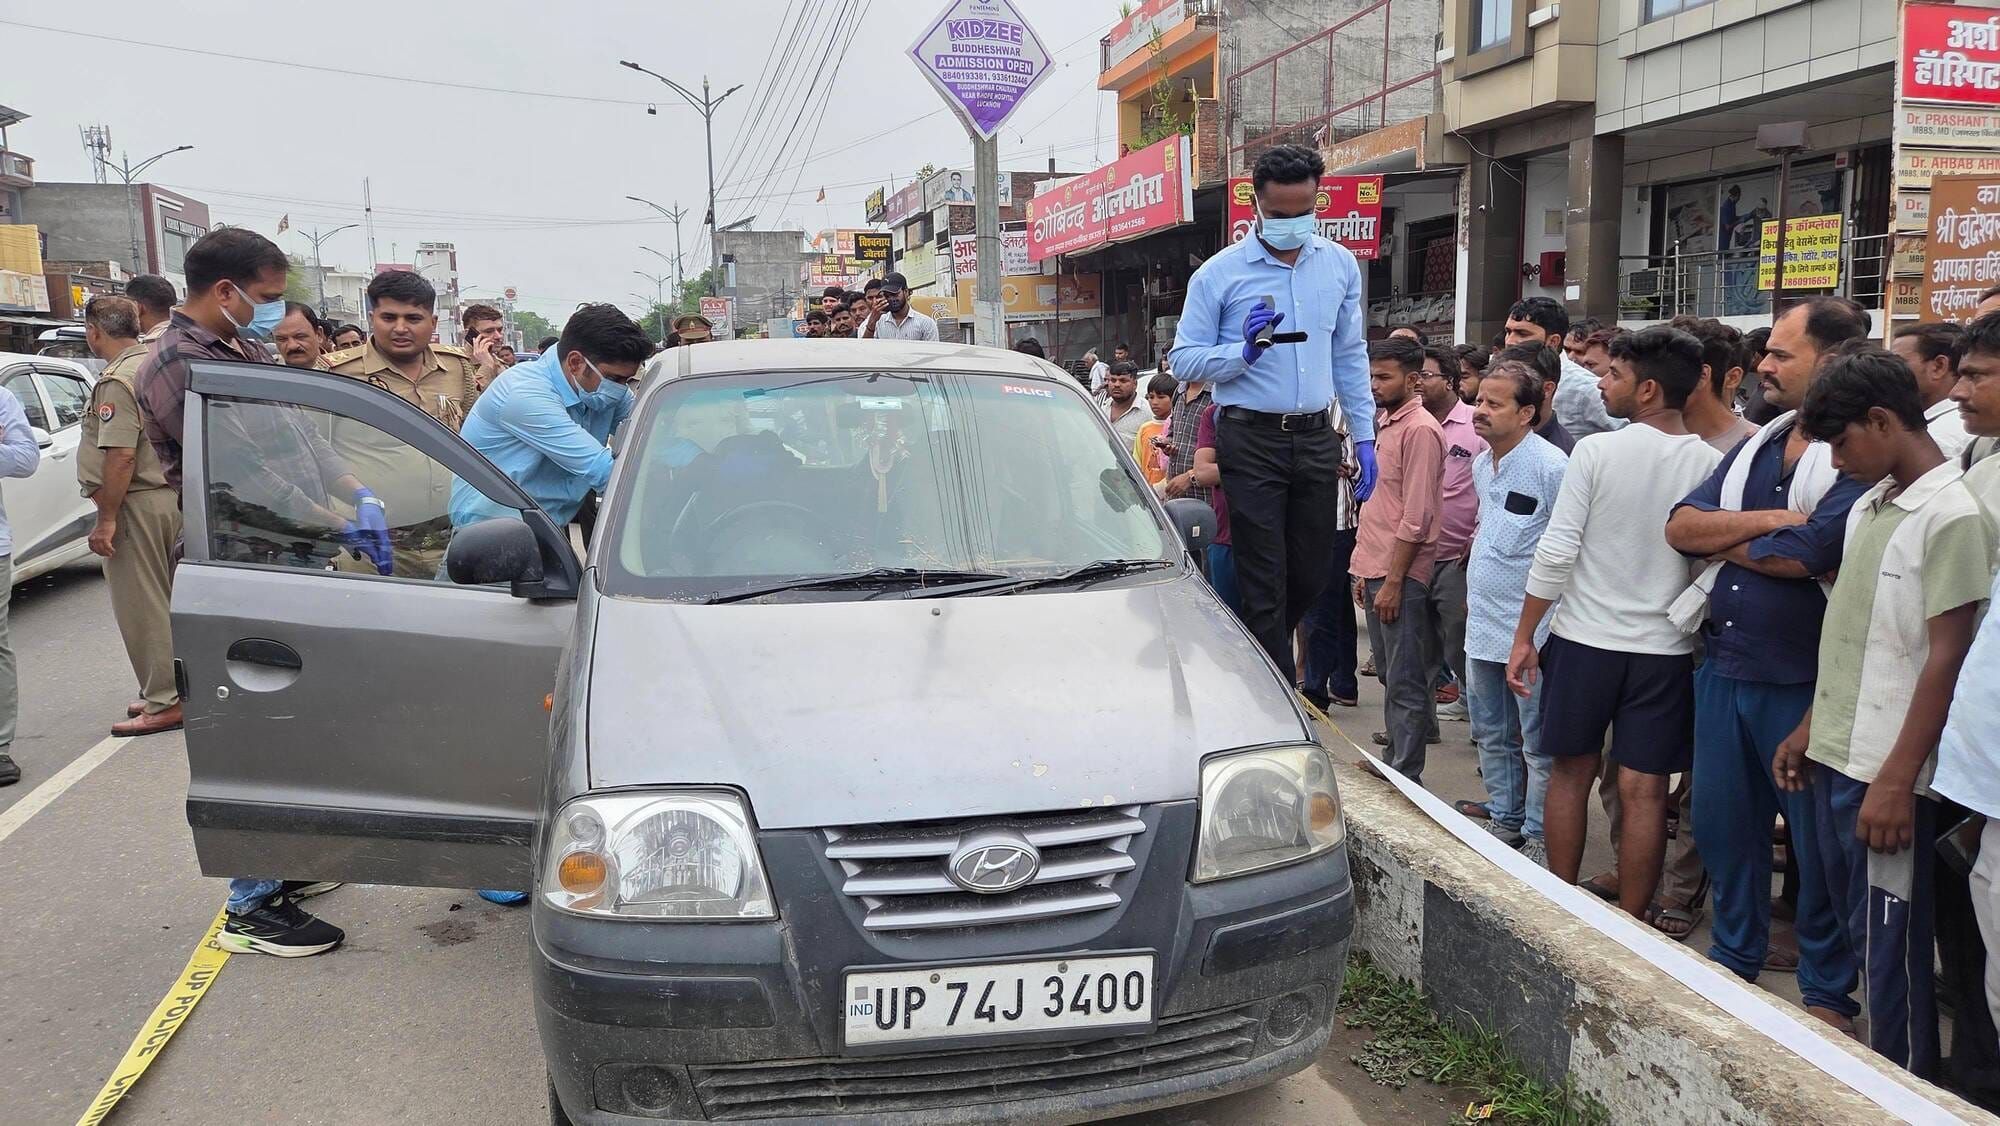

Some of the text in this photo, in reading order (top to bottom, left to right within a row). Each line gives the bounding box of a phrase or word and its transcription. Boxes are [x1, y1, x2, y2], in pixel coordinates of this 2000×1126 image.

[946, 19, 1023, 45] KIDZEE
[951, 44, 1021, 57] BUDDHESHWAR
[938, 56, 1032, 74] ADMISSION OPEN
[1913, 49, 2000, 89] हॉस्पिट
[1906, 112, 1921, 124] Dr.
[1925, 113, 1989, 127] PRASHANT
[1912, 126, 1935, 136] MBBS,
[1911, 155, 1927, 168] Dr.
[1931, 156, 1974, 170] AHBAB
[1905, 199, 1924, 210] Dr.
[1936, 207, 1958, 243] श्री
[1898, 284, 1918, 296] Dr.
[1005, 385, 1053, 398] POLICE
[185, 970, 214, 991] UP
[876, 970, 1145, 1031] UP 74J 3400
[850, 1003, 873, 1016] IND
[137, 994, 198, 1058] POLICE
